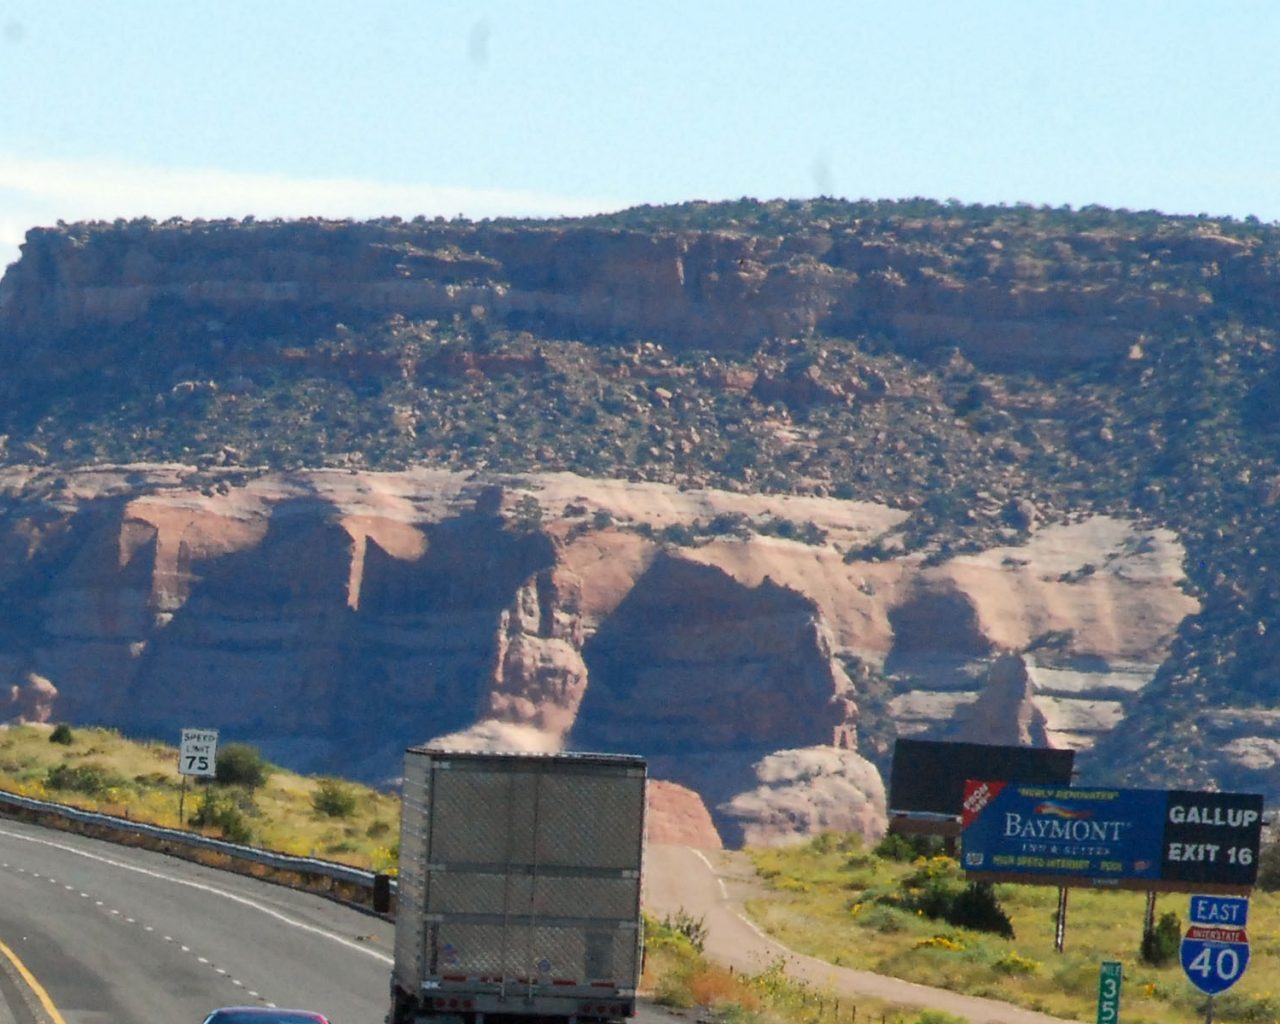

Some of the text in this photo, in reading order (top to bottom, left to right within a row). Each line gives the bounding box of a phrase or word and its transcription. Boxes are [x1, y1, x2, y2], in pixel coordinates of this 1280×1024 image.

[184, 733, 215, 742] SPEED
[185, 755, 208, 771] 75
[1169, 805, 1258, 827] GALLUP
[1003, 812, 1125, 842] BAYMONT
[1168, 842, 1253, 866] EXIT 16
[1197, 900, 1240, 921] EAST
[1193, 930, 1240, 942] INTERSTATE
[1189, 948, 1239, 980] 40
